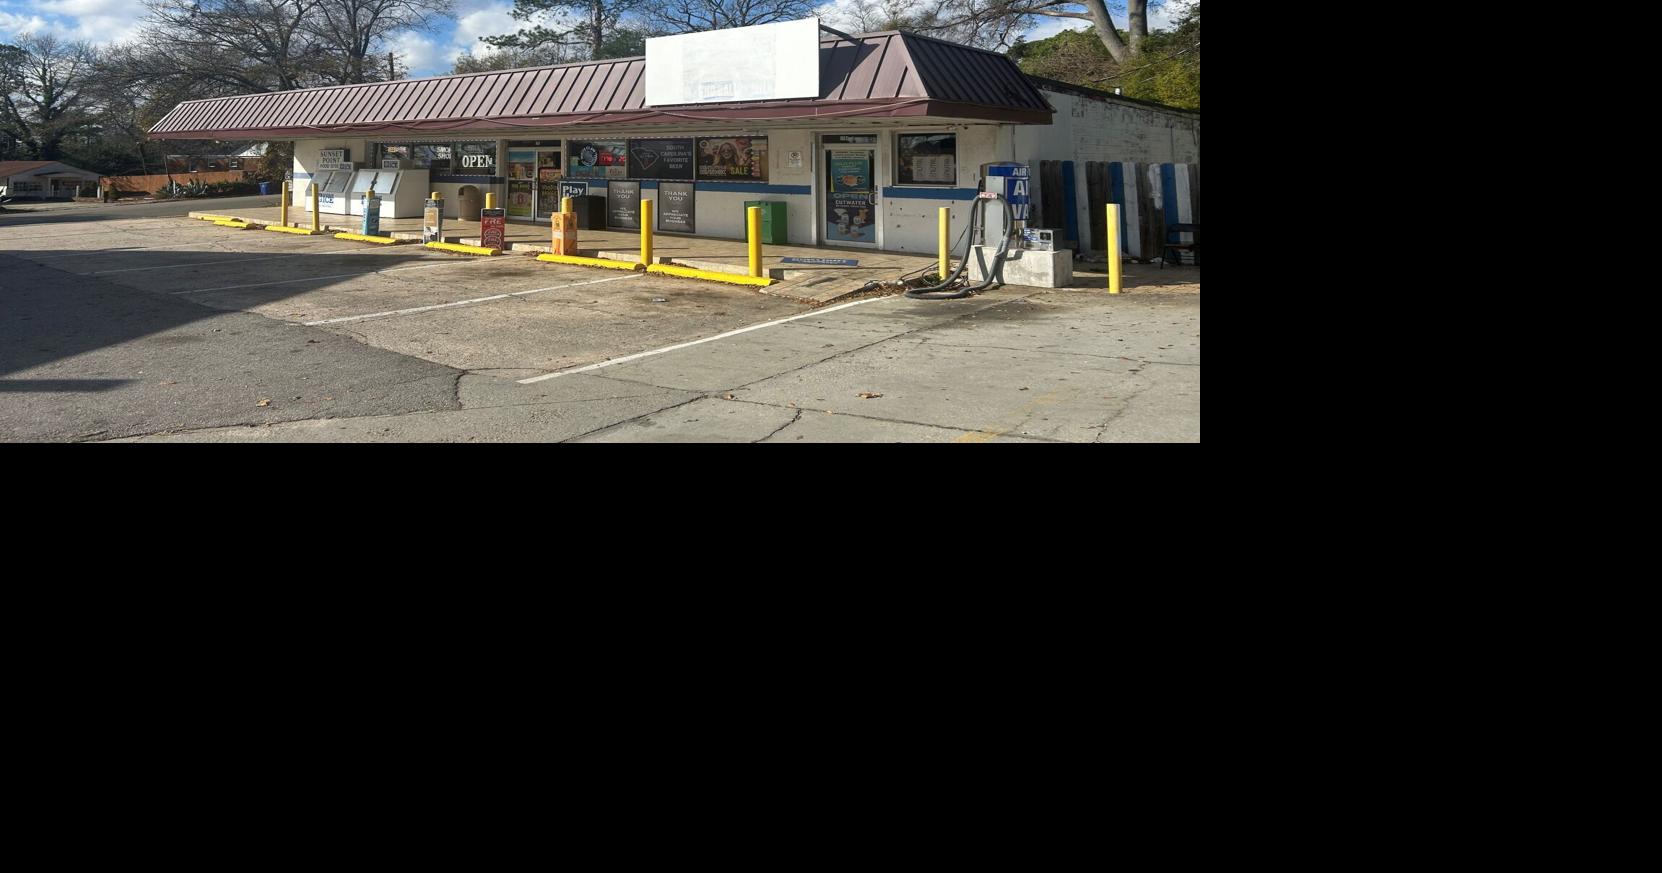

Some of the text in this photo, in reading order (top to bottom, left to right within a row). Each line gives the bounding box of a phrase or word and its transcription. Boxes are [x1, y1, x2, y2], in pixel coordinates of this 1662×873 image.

[462, 154, 493, 168] OPEN
[730, 166, 749, 175] SALE
[1012, 167, 1027, 177] AIR
[562, 185, 584, 196] Play
